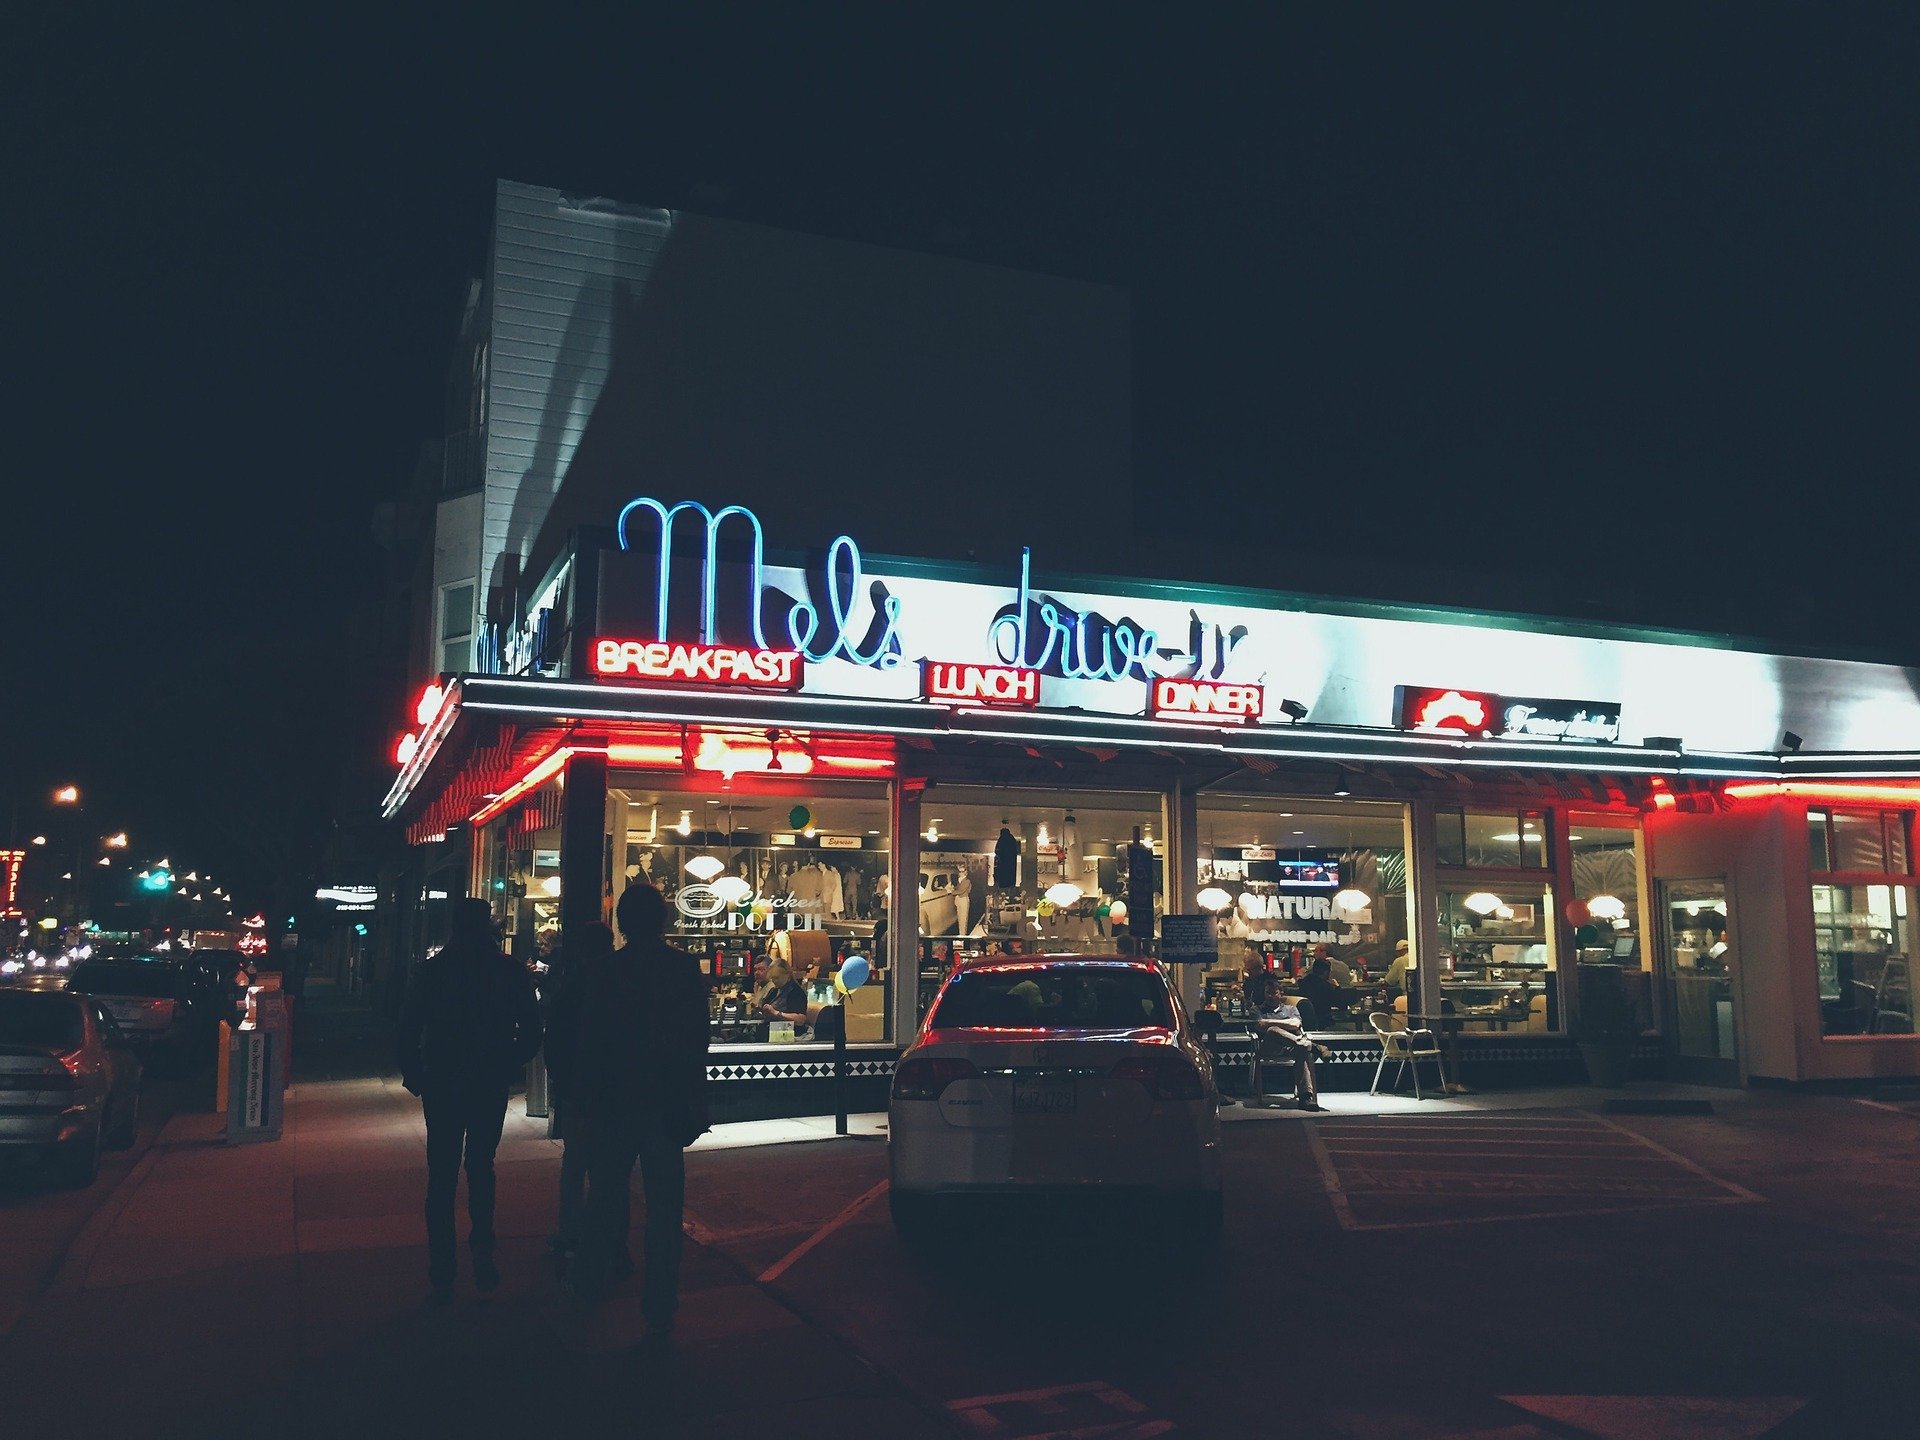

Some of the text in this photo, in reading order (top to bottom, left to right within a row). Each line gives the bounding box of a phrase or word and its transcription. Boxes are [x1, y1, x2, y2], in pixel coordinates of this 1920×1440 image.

[616, 496, 906, 669] Mels
[597, 640, 799, 682] BREAKFAST
[933, 664, 1035, 700] LUNCH
[1158, 681, 1260, 714] DINNER
[828, 837, 854, 846] Espresso
[735, 889, 823, 908] Chicken
[1246, 894, 1348, 920] NATURA
[674, 919, 726, 929] Fresh Baked
[728, 912, 778, 931] POT
[250, 1039, 261, 1053] San
[249, 1102, 259, 1122] News
